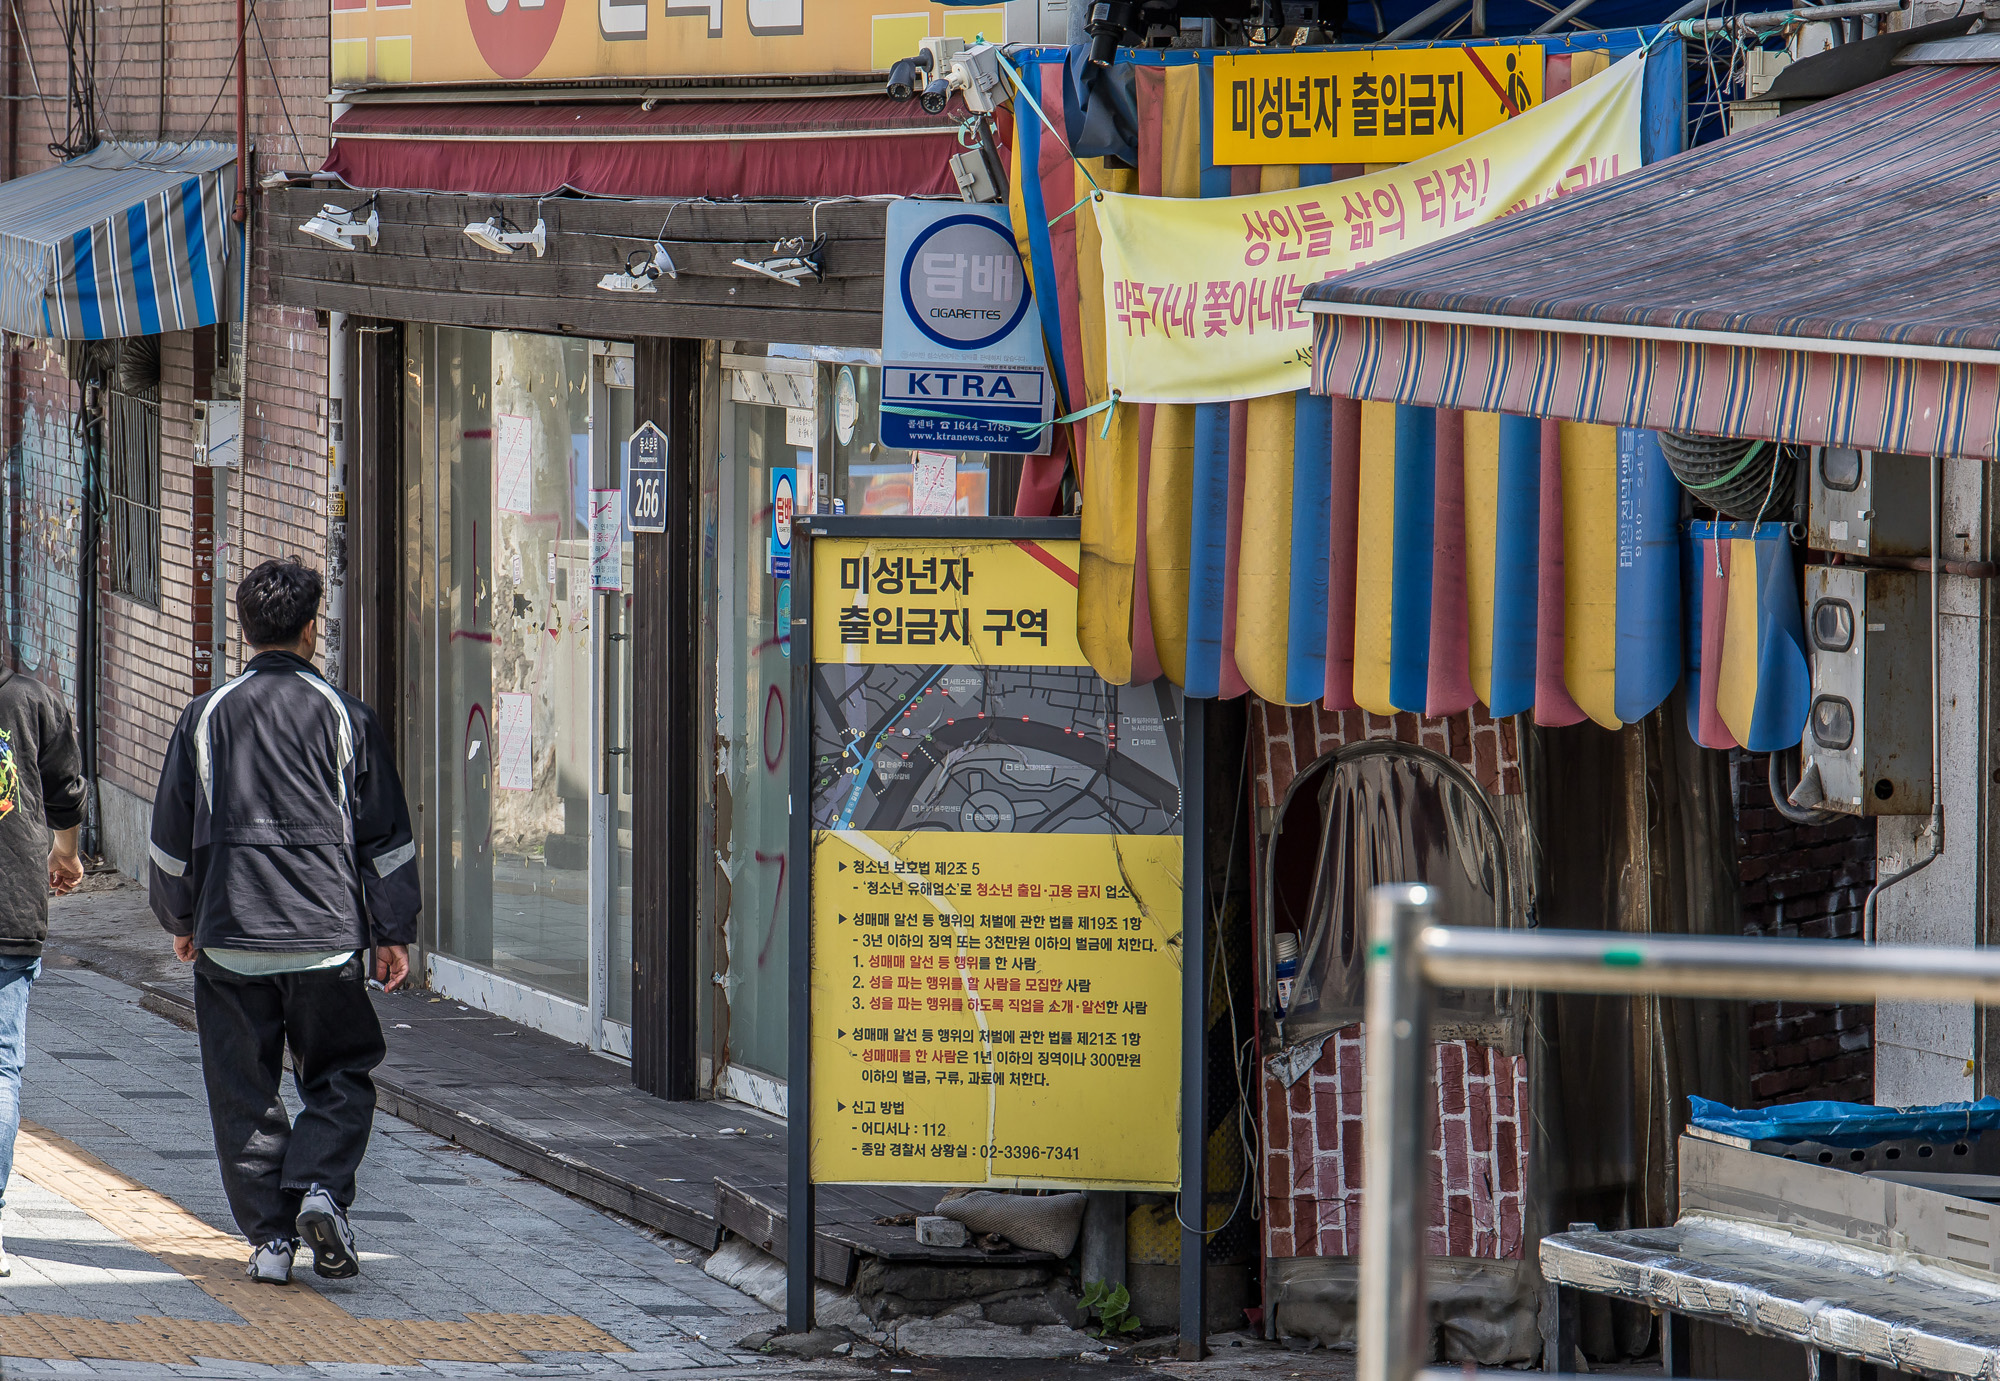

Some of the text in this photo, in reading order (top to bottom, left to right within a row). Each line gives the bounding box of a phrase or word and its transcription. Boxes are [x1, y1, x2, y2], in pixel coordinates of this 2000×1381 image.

[1233, 71, 1463, 139] 미성년자 출입금지
[1241, 201, 1334, 266] 상인들
[1343, 182, 1406, 250] 삶의
[1414, 158, 1492, 228] 터전!
[922, 252, 1014, 301] 담배
[930, 308, 1001, 320] CIGARETTES
[1114, 273, 1312, 338] 막무가내 쫓아내는
[908, 373, 1016, 398] KTRA
[908, 419, 935, 429] 콜센타
[639, 437, 658, 454] 동소문로
[909, 432, 1008, 443] www.ktranews.co.kr
[635, 478, 659, 518] 266
[841, 555, 974, 595] 미성년자
[839, 605, 971, 647] 출입금지
[983, 609, 1047, 646] 구역
[854, 859, 980, 875] 청소년 보호법 제2조 5
[977, 883, 1012, 897] 청소년
[1018, 883, 1072, 899] 출입·고용
[1077, 885, 1100, 898] 금지
[1106, 884, 1131, 899] 업소
[853, 913, 1143, 930] 성매매 알선 등 행위의 처벌에 관한 법률 제19조 1항
[863, 934, 1157, 952] 3년 이하의 징역 또는 3천만원 이하의 벌금에 처한다.
[853, 955, 1038, 972] 1. 성매매 알선 등 행위를 한 사람
[853, 976, 1091, 992] 2. 성을 파는 행위를 할 사람을 모집한 사람
[853, 996, 864, 1009] 3.
[870, 997, 893, 1010] 성을
[898, 997, 922, 1010] 파는
[927, 997, 963, 1011] 행위를
[968, 998, 1004, 1012] 하도록
[1009, 999, 1044, 1013] 직업을
[1123, 1001, 1147, 1015] 사람
[852, 1028, 1141, 1046] 성매매 알선 등 행위의 처벌에 관한 법률 제21조 1항
[862, 1049, 1140, 1067] 성매매를 한 사람은 1년 이하의 징역이나 300만원
[862, 1069, 1049, 1086] 이하의 벌금, 구류, 과료에 처한다.
[852, 1101, 904, 1115] 신고 방법
[862, 1122, 910, 1136] 어디서나
[923, 1123, 945, 1136] 112
[862, 1143, 886, 1156] 종암
[890, 1143, 925, 1157] 경찰서
[931, 1144, 967, 1158] 상황실
[980, 1145, 1078, 1160] 02-3396-7341
